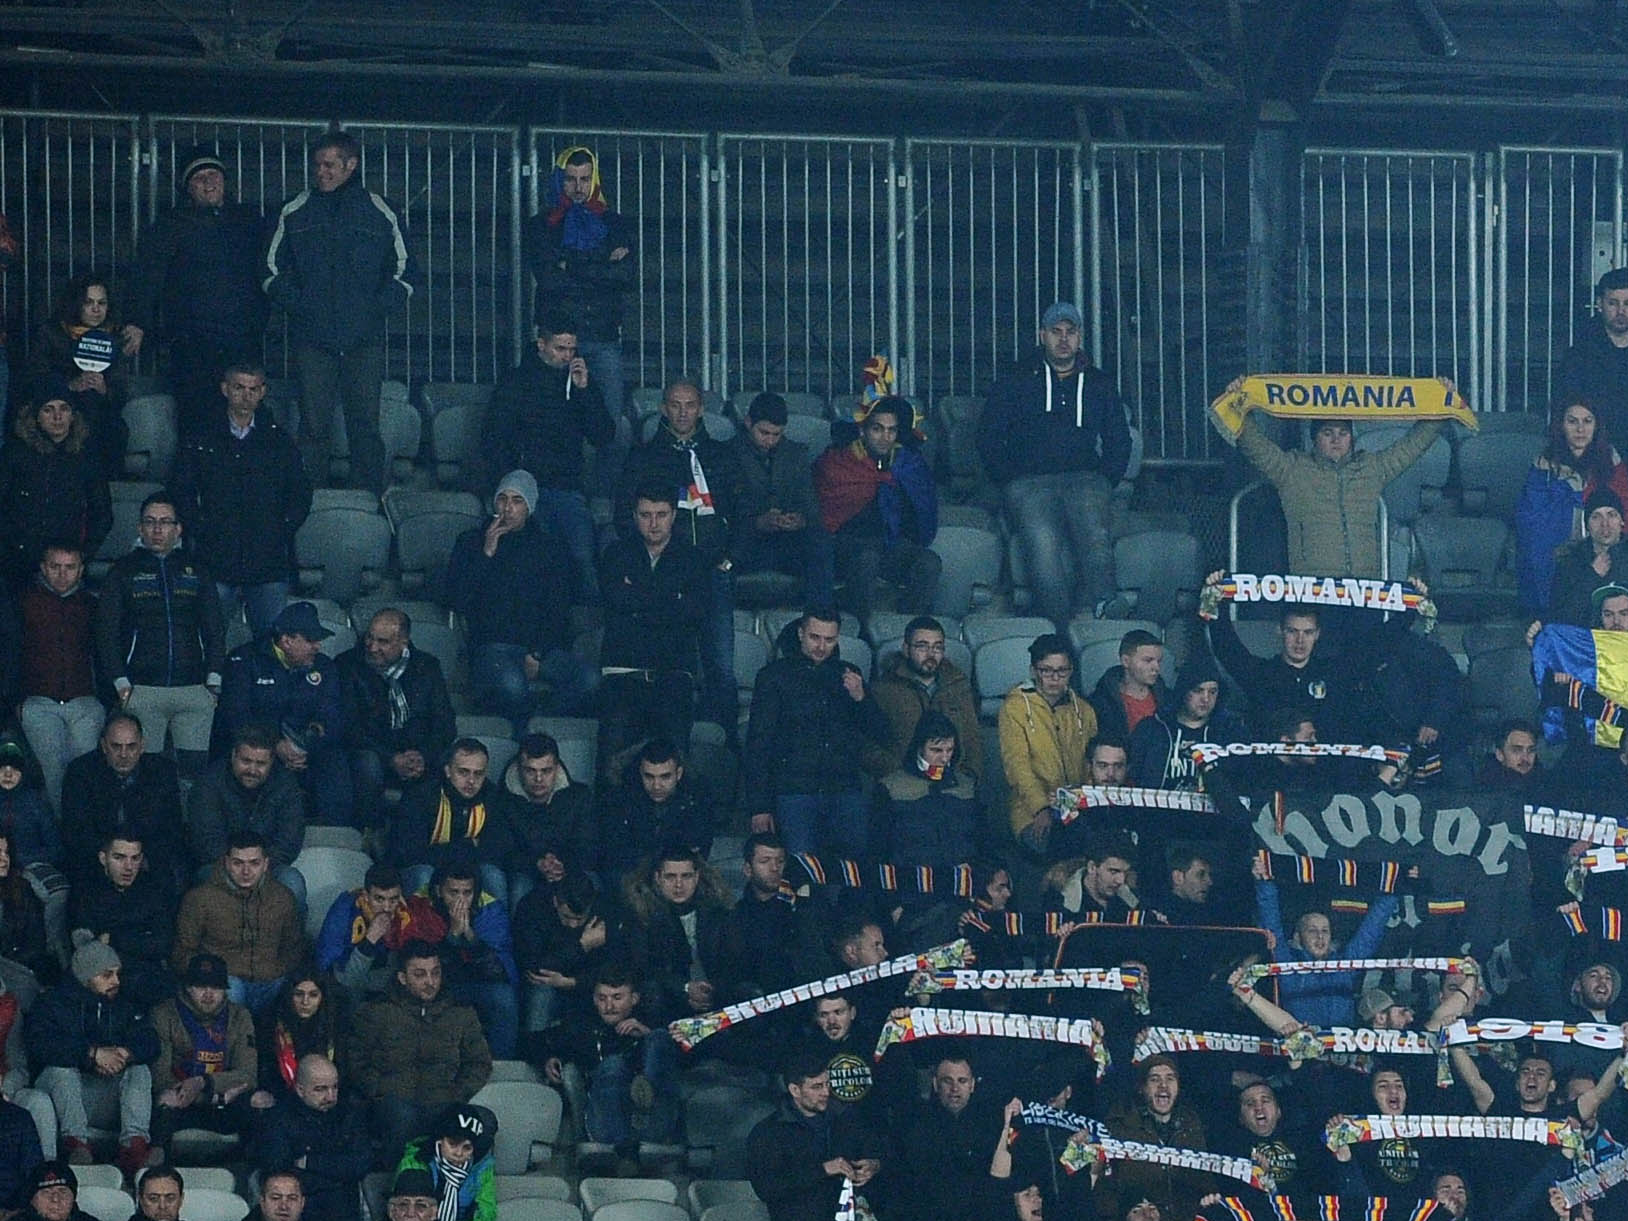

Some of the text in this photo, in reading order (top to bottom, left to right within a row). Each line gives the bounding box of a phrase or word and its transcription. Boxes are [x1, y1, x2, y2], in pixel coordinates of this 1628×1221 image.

[1231, 574, 1407, 611] ROMANIA
[1252, 790, 1528, 875] honor
[952, 968, 1124, 991] ROMANIA
[1447, 1017, 1624, 1050] 1918
